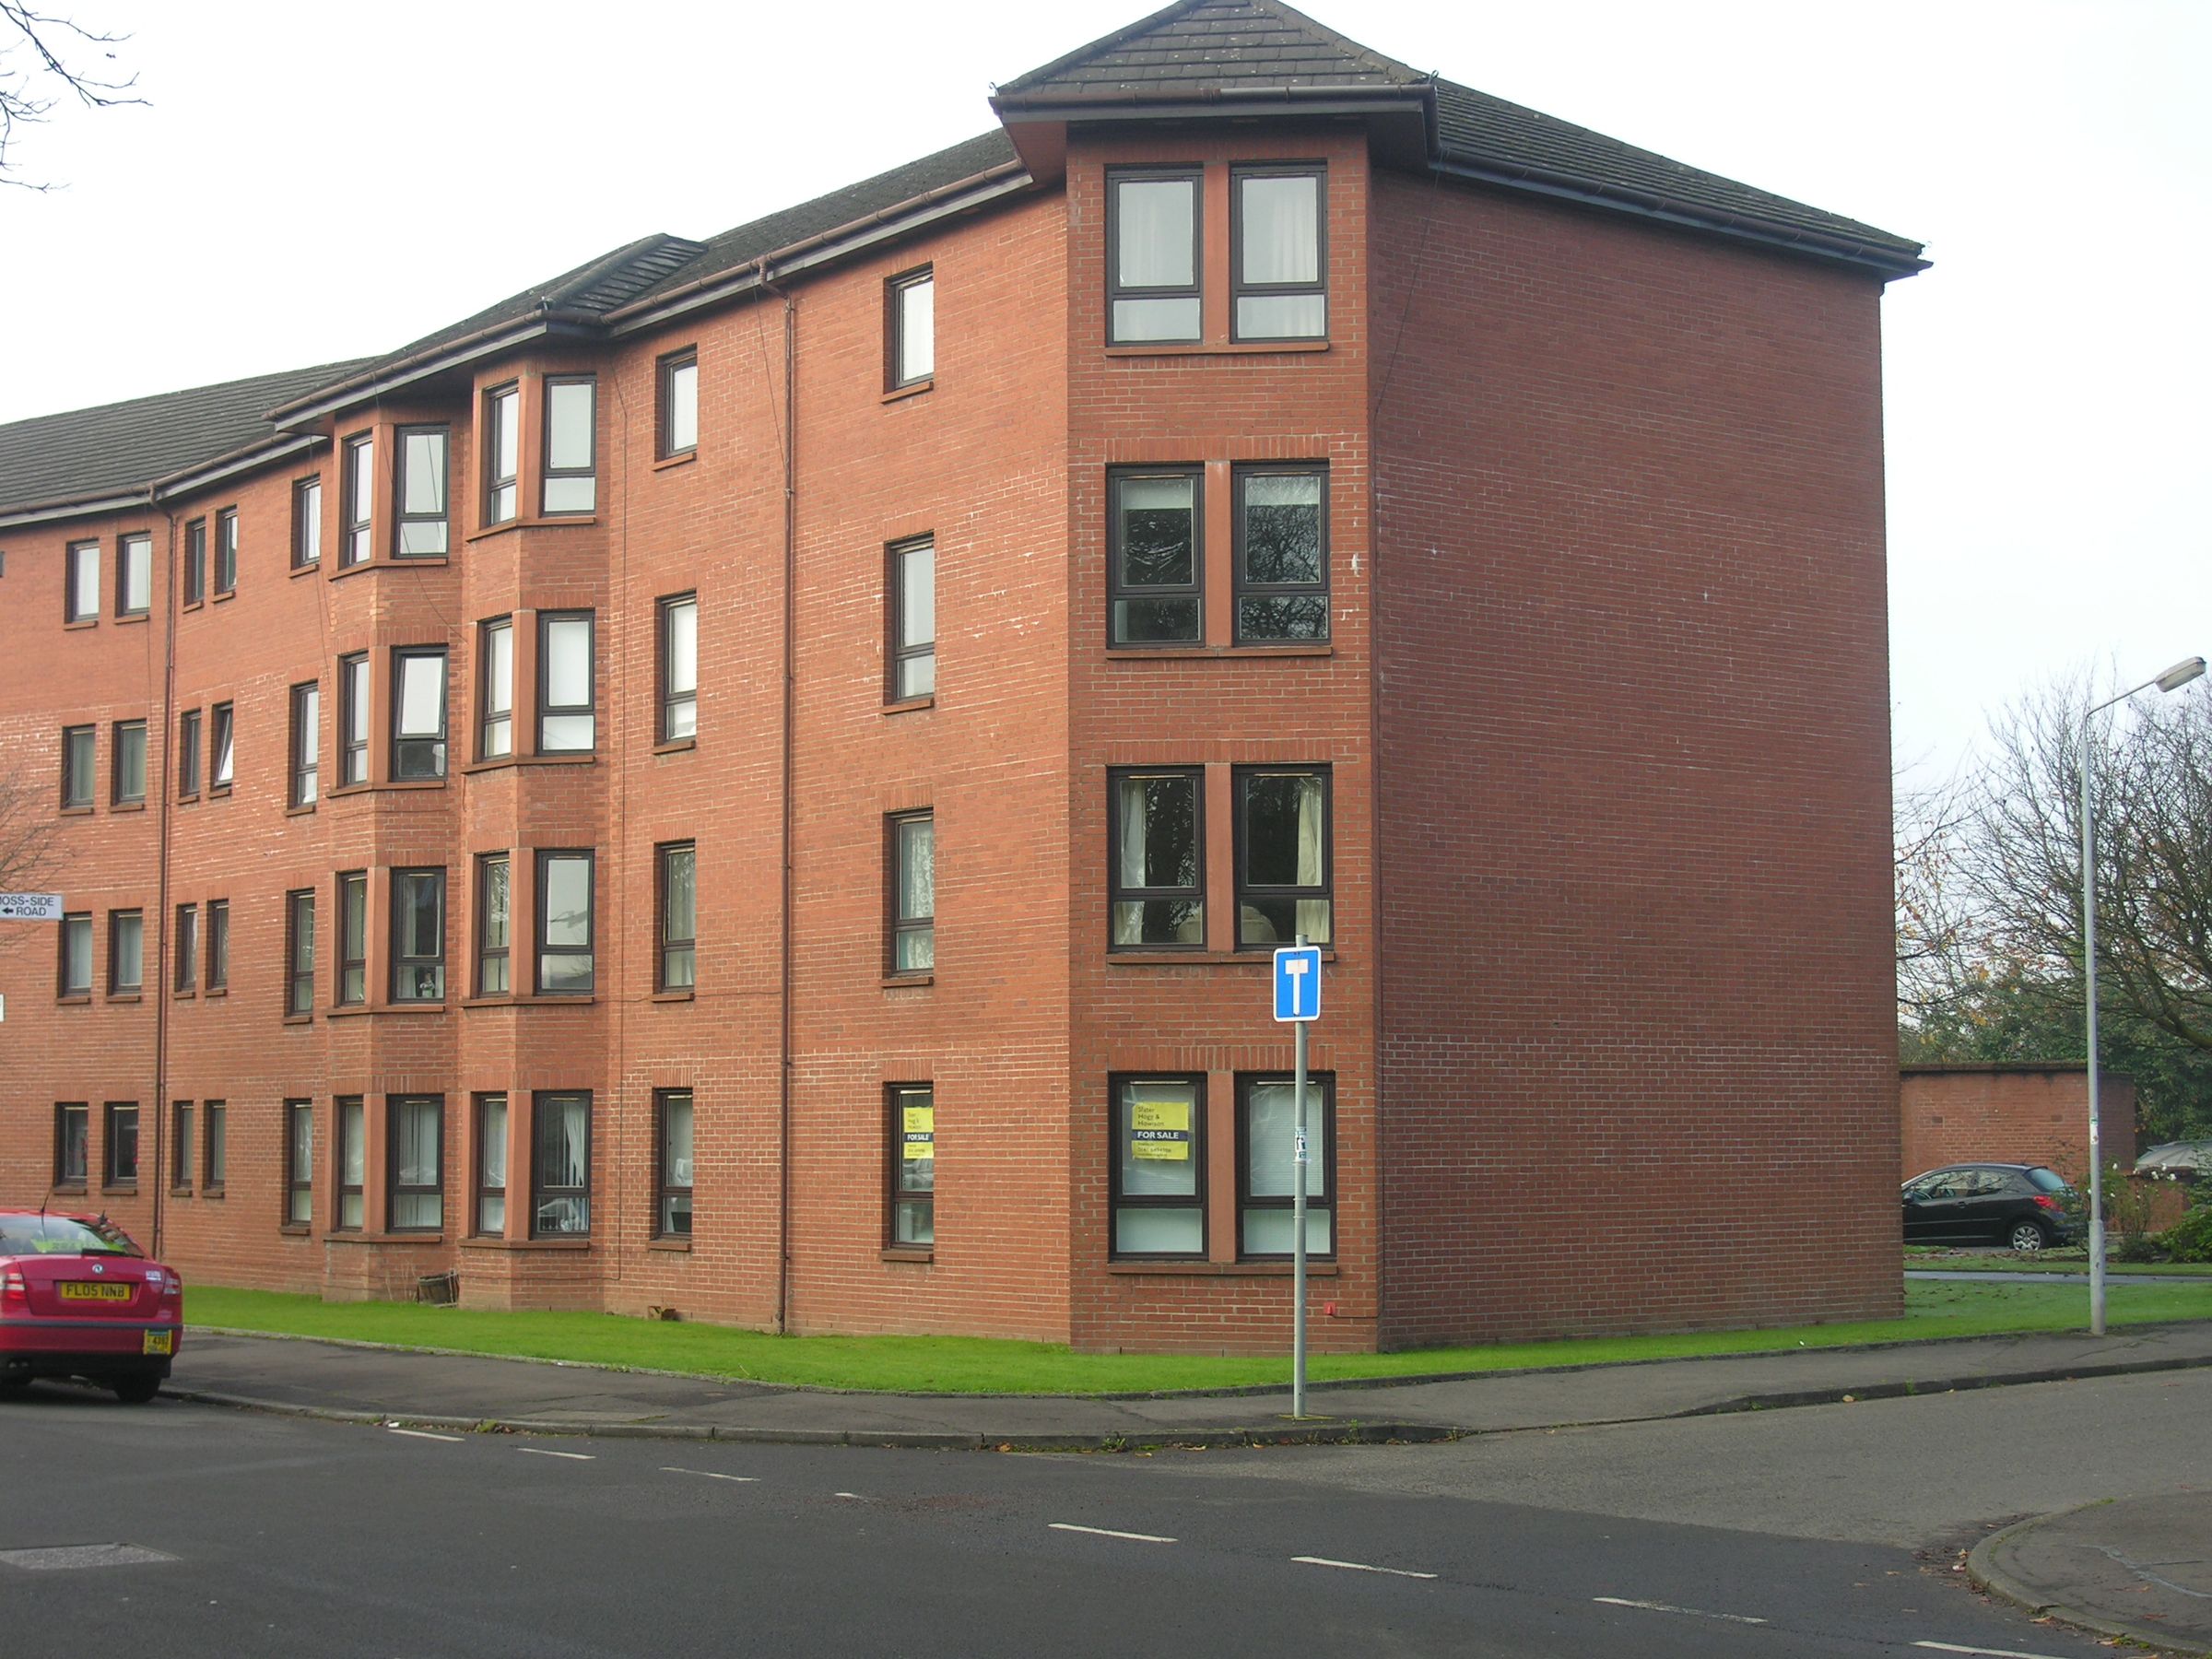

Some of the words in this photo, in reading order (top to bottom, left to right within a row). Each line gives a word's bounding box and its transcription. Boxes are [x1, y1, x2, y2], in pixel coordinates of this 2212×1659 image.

[0, 895, 54, 907] OSS-SIDE
[16, 906, 47, 916] ROAD
[1137, 1131, 1156, 1139] FOR
[1157, 1131, 1179, 1140] SALE
[65, 1283, 98, 1298] FL05
[101, 1284, 125, 1299] NNB
